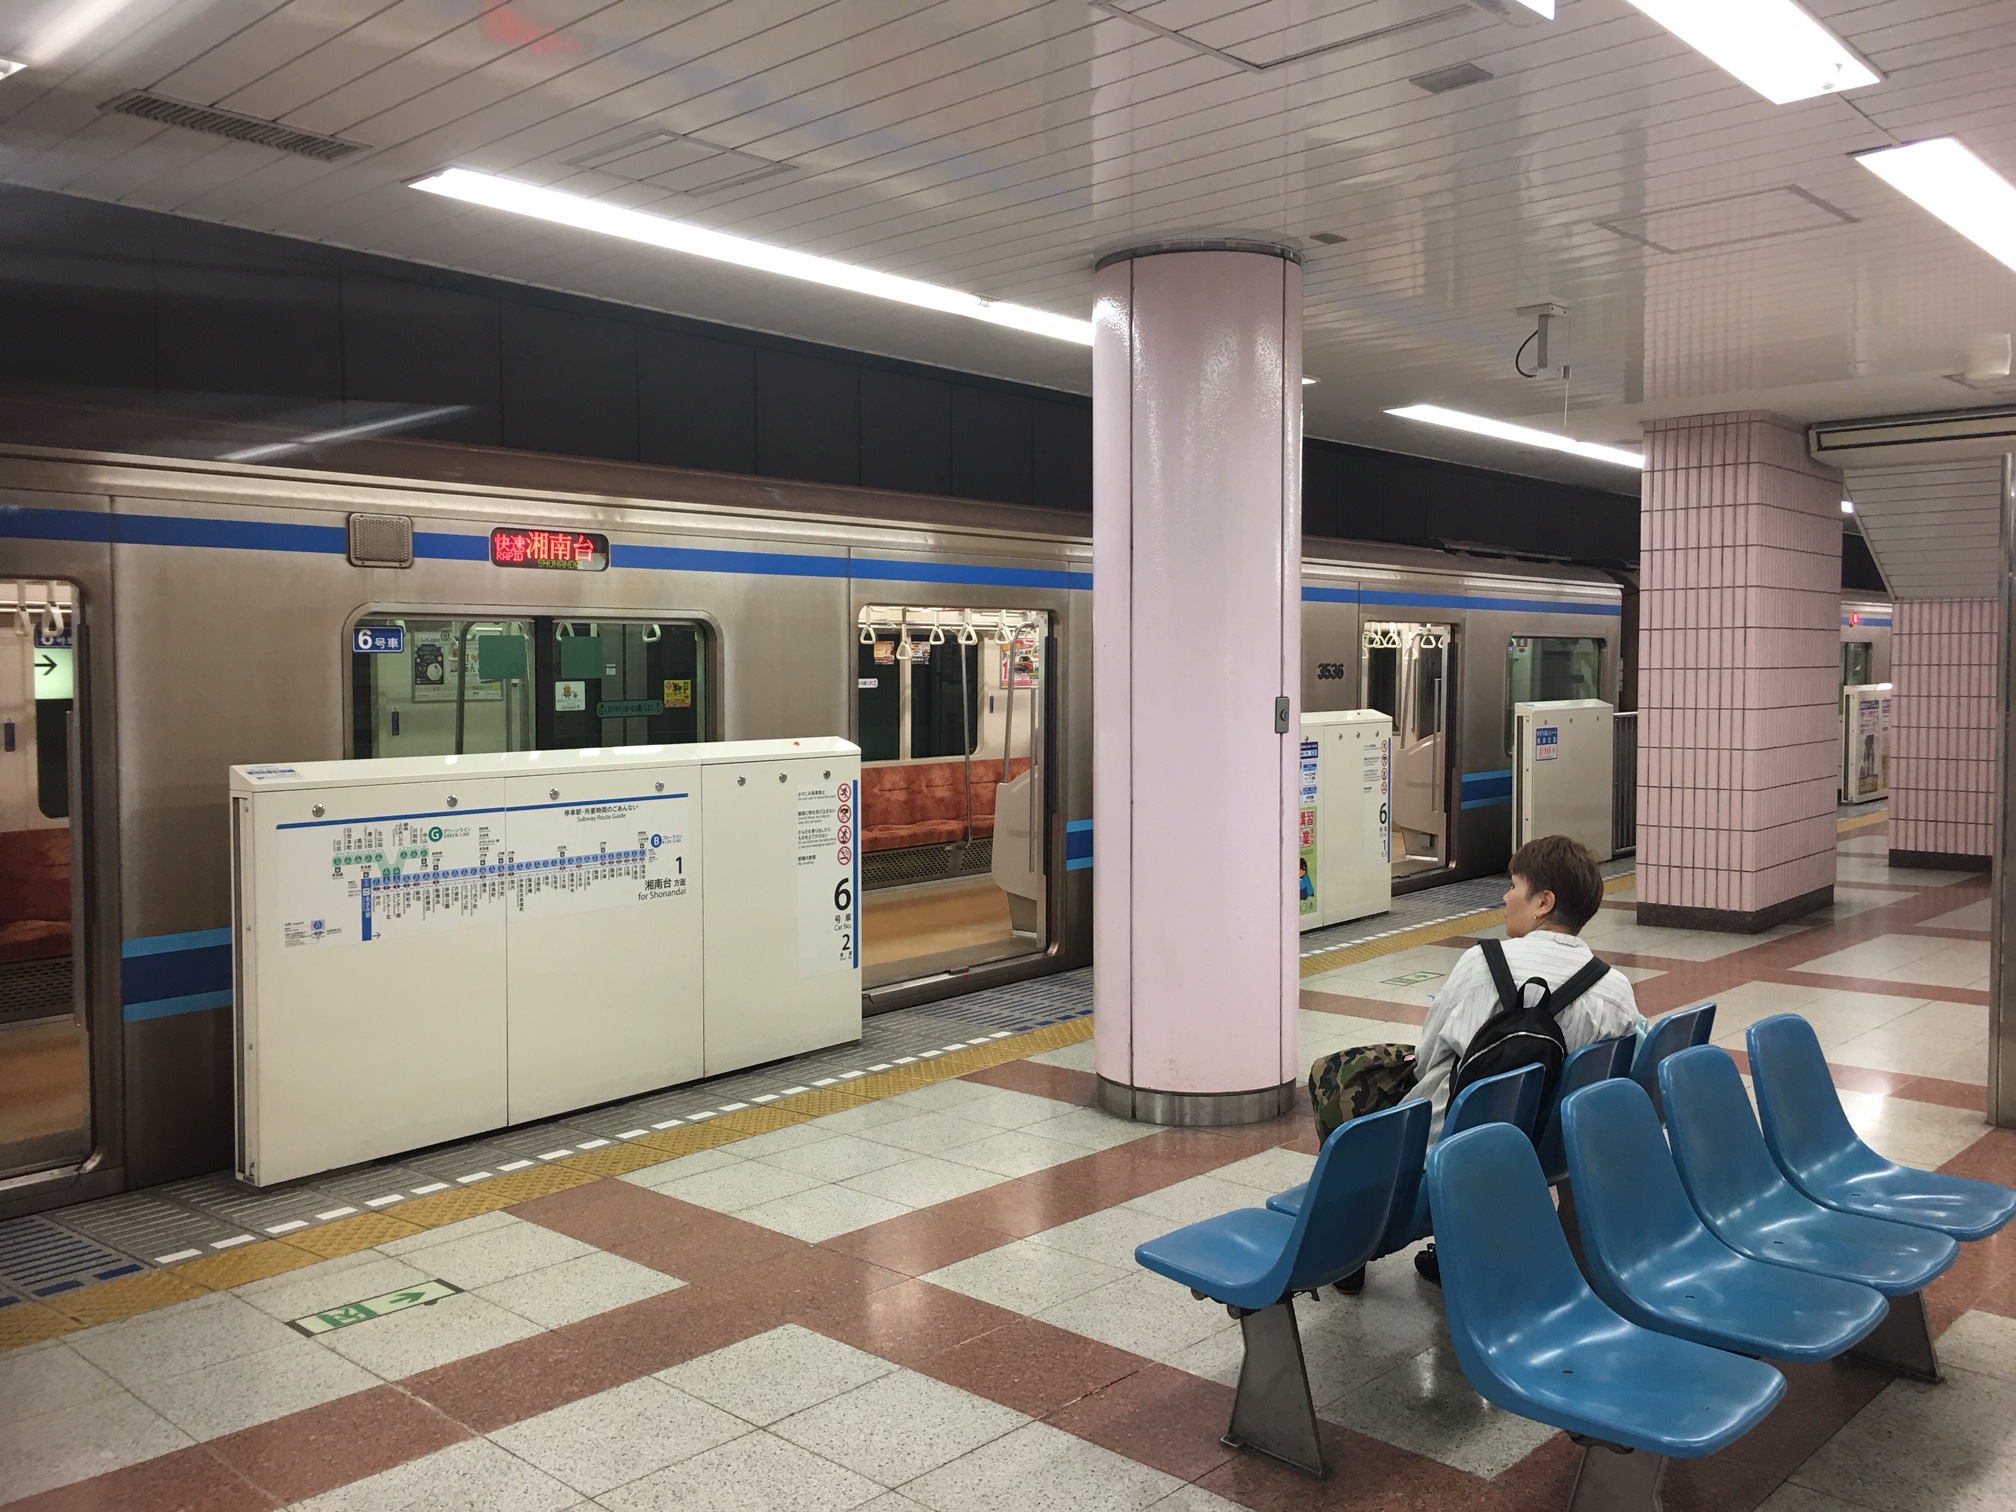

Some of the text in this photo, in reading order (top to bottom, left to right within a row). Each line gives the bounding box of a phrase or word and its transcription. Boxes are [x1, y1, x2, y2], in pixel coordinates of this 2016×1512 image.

[494, 531, 594, 562] 快速 湘南台
[496, 551, 524, 562] RAPID
[358, 629, 399, 649] 6号車
[1317, 662, 1344, 680] 3536
[612, 812, 627, 820] Guide
[1379, 802, 1387, 824] 6
[1382, 839, 1386, 850] 1
[675, 856, 682, 874] 1
[644, 878, 686, 891] 湘南台 方面
[638, 887, 686, 901] for Shonandai
[834, 877, 851, 911] 6
[834, 913, 851, 923] 号車
[842, 934, 850, 951] 2
